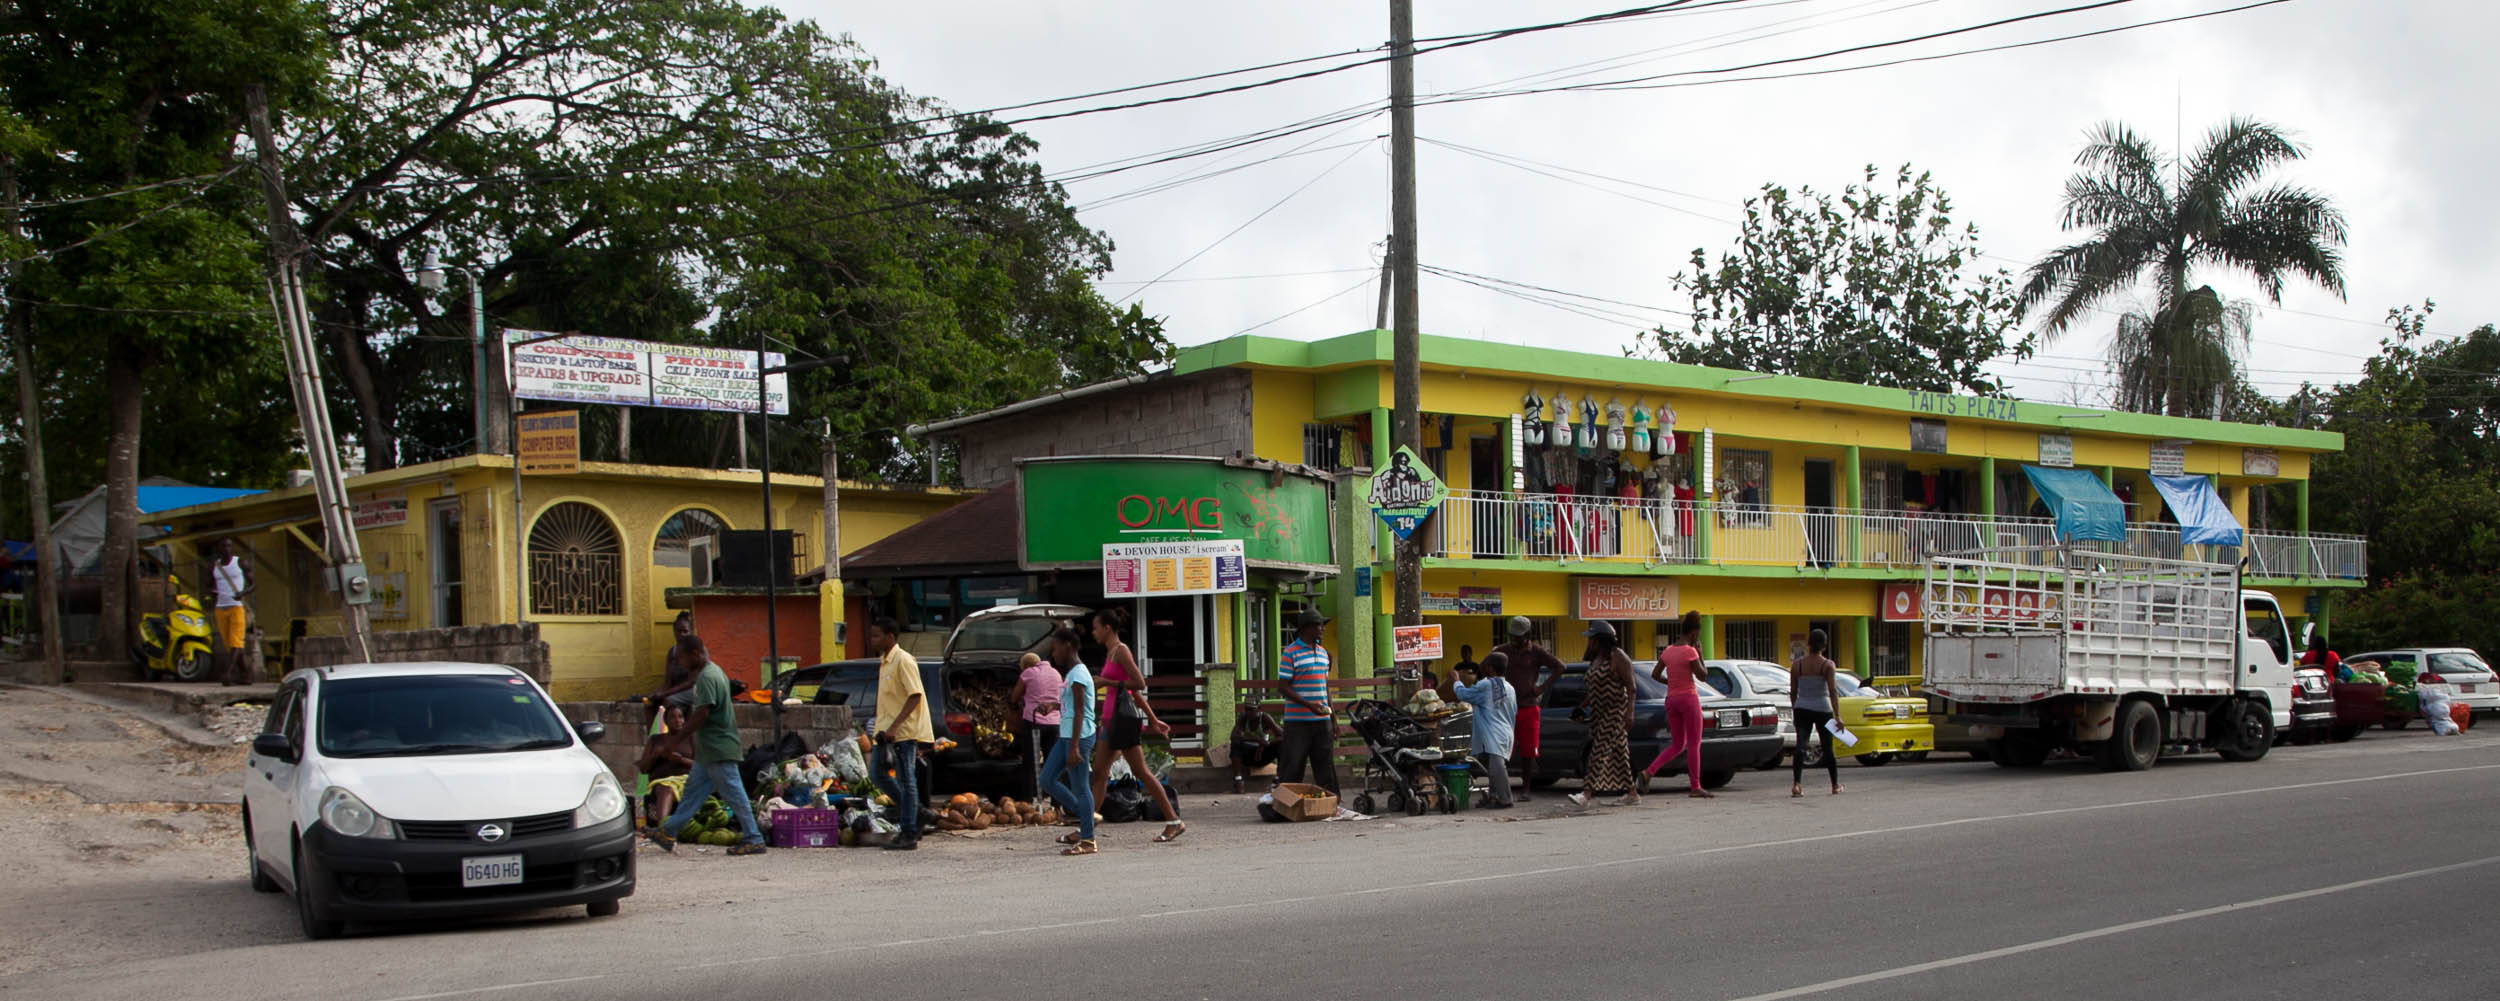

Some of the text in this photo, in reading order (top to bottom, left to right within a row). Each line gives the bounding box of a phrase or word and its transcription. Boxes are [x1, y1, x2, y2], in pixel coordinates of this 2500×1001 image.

[634, 342, 700, 357] COMPUTER
[703, 347, 745, 360] WORKS
[560, 357, 567, 366] &
[569, 356, 606, 368] LAPTOP
[664, 355, 745, 369] PHONES
[569, 369, 578, 381] &
[581, 371, 641, 385] UPGRADE
[665, 366, 760, 380] CELL PHONE SALE
[655, 386, 680, 396] CELL
[684, 387, 719, 398] PHONE
[1968, 396, 2017, 421] PLAZA
[1118, 495, 1222, 536] OMG
[1125, 547, 1158, 556] DEVON
[1160, 545, 1190, 555] HOUSE
[466, 862, 520, 880] 0640 HG
